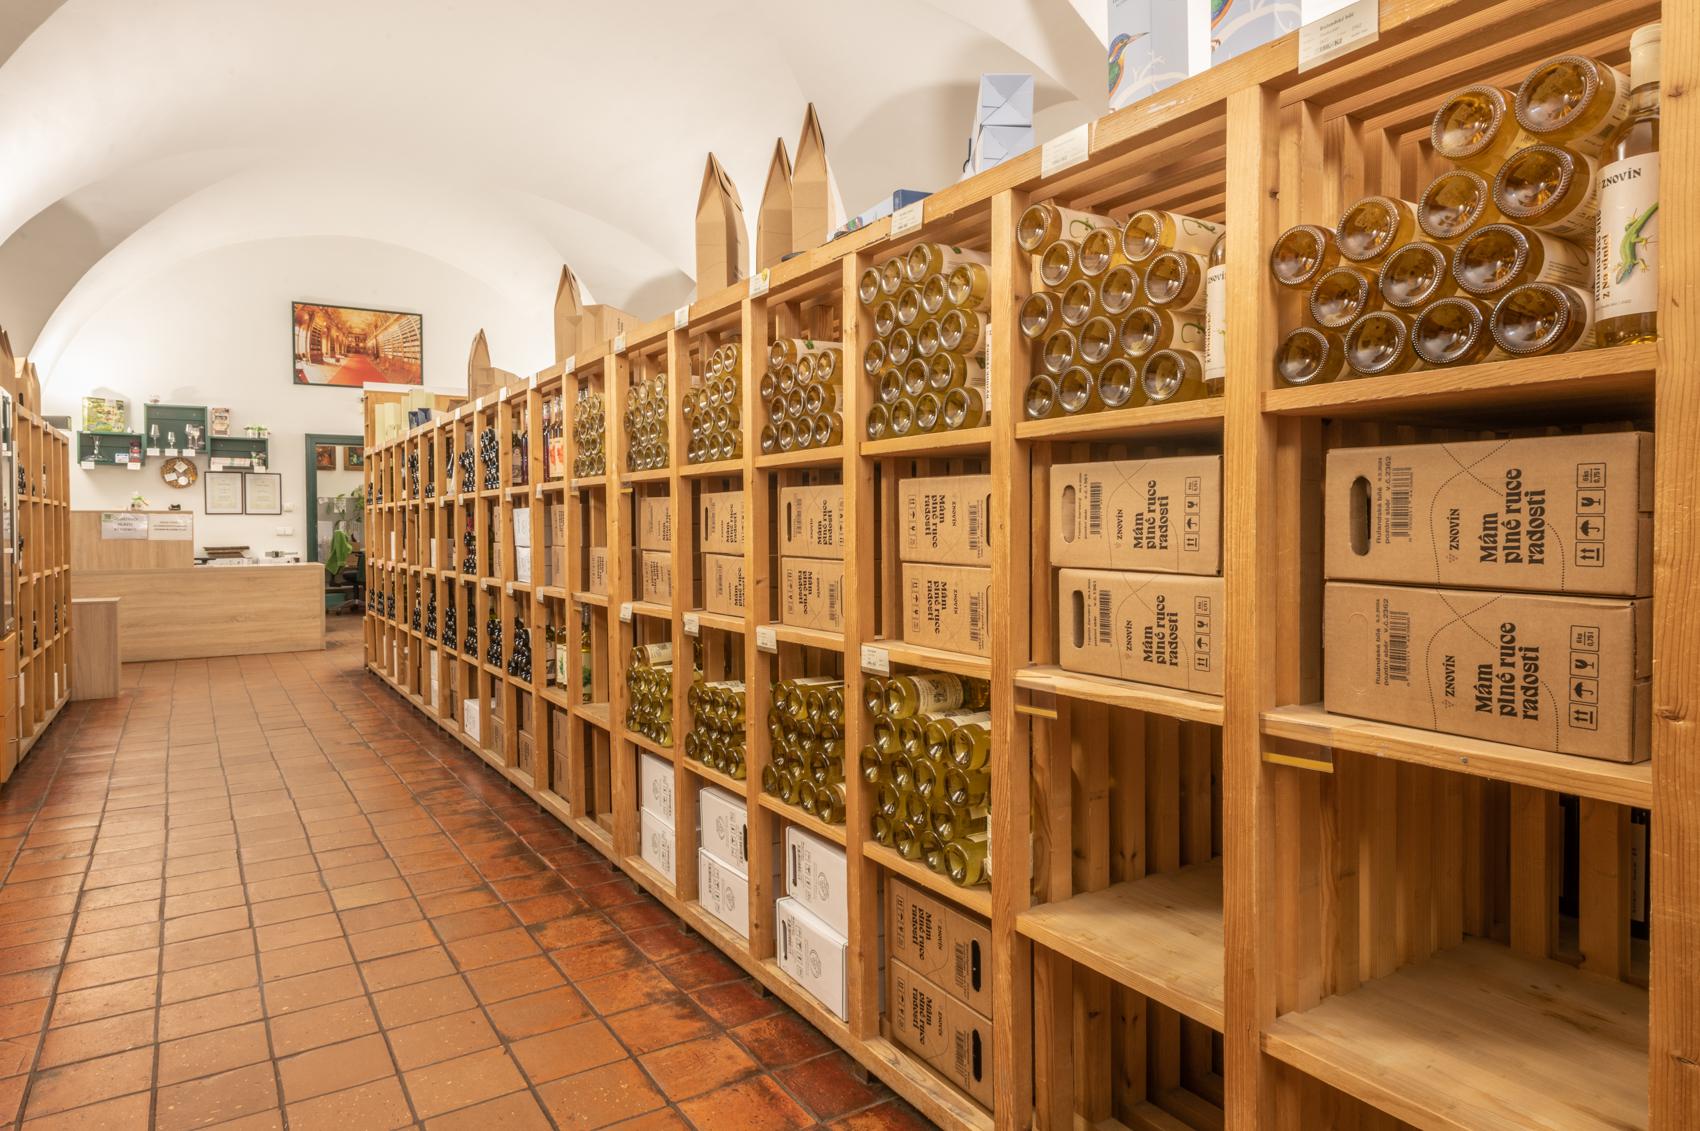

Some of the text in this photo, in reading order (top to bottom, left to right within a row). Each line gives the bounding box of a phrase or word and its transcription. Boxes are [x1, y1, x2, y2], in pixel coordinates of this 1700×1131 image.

[1602, 168, 1642, 189] ZNOVÍN
[1133, 512, 1143, 549] Mám
[1146, 480, 1157, 550] plné ruce
[1158, 496, 1169, 550] radosti
[1448, 508, 1461, 551] ZNOVÍN
[1479, 512, 1499, 564] Mám
[1501, 468, 1523, 564] plné ruce
[1525, 489, 1546, 566] radosti
[1142, 626, 1153, 663] Mám
[1155, 595, 1166, 665] plné ruce
[1167, 612, 1178, 667] radosti
[1444, 655, 1456, 697] ZNOVÍN
[1474, 663, 1493, 714] Mám
[1496, 622, 1518, 718] plné ruce
[1519, 646, 1540, 721] radosti
